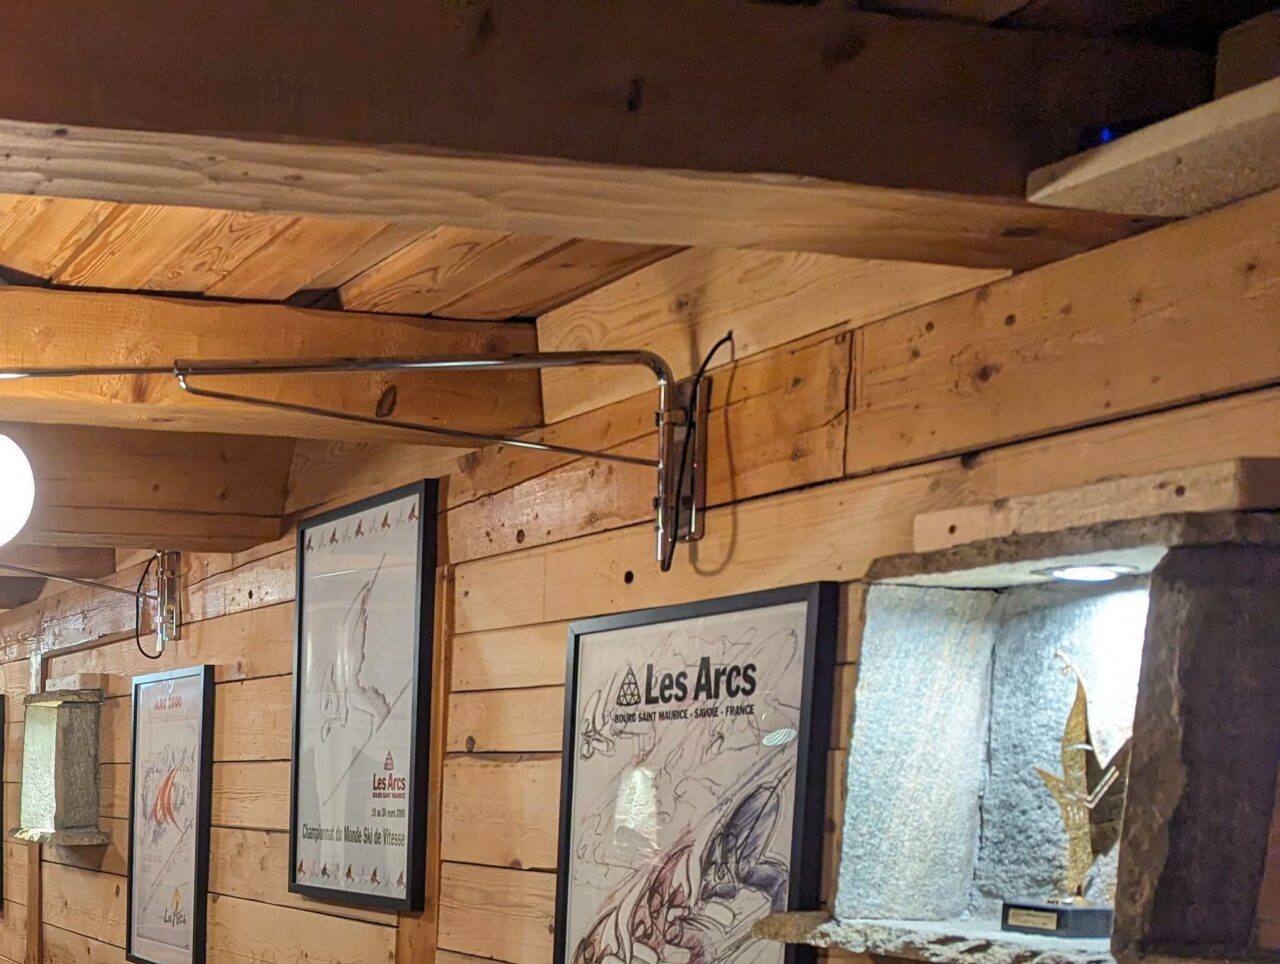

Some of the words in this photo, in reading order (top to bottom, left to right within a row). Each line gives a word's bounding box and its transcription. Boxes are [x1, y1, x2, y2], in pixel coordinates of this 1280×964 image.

[645, 663, 688, 705] Les
[693, 656, 757, 701] Arcs
[615, 713, 636, 724] BOURG
[638, 711, 656, 723] SAINT
[658, 709, 688, 722] MAURICE
[694, 706, 719, 719] SAVOIE
[725, 704, 755, 716] FRANCE
[372, 772, 386, 791] Les
[387, 772, 406, 791] Arcs
[343, 825, 362, 844] Monde
[363, 826, 372, 844] Ski
[374, 829, 381, 845] de
[382, 827, 405, 847] Vitesse
